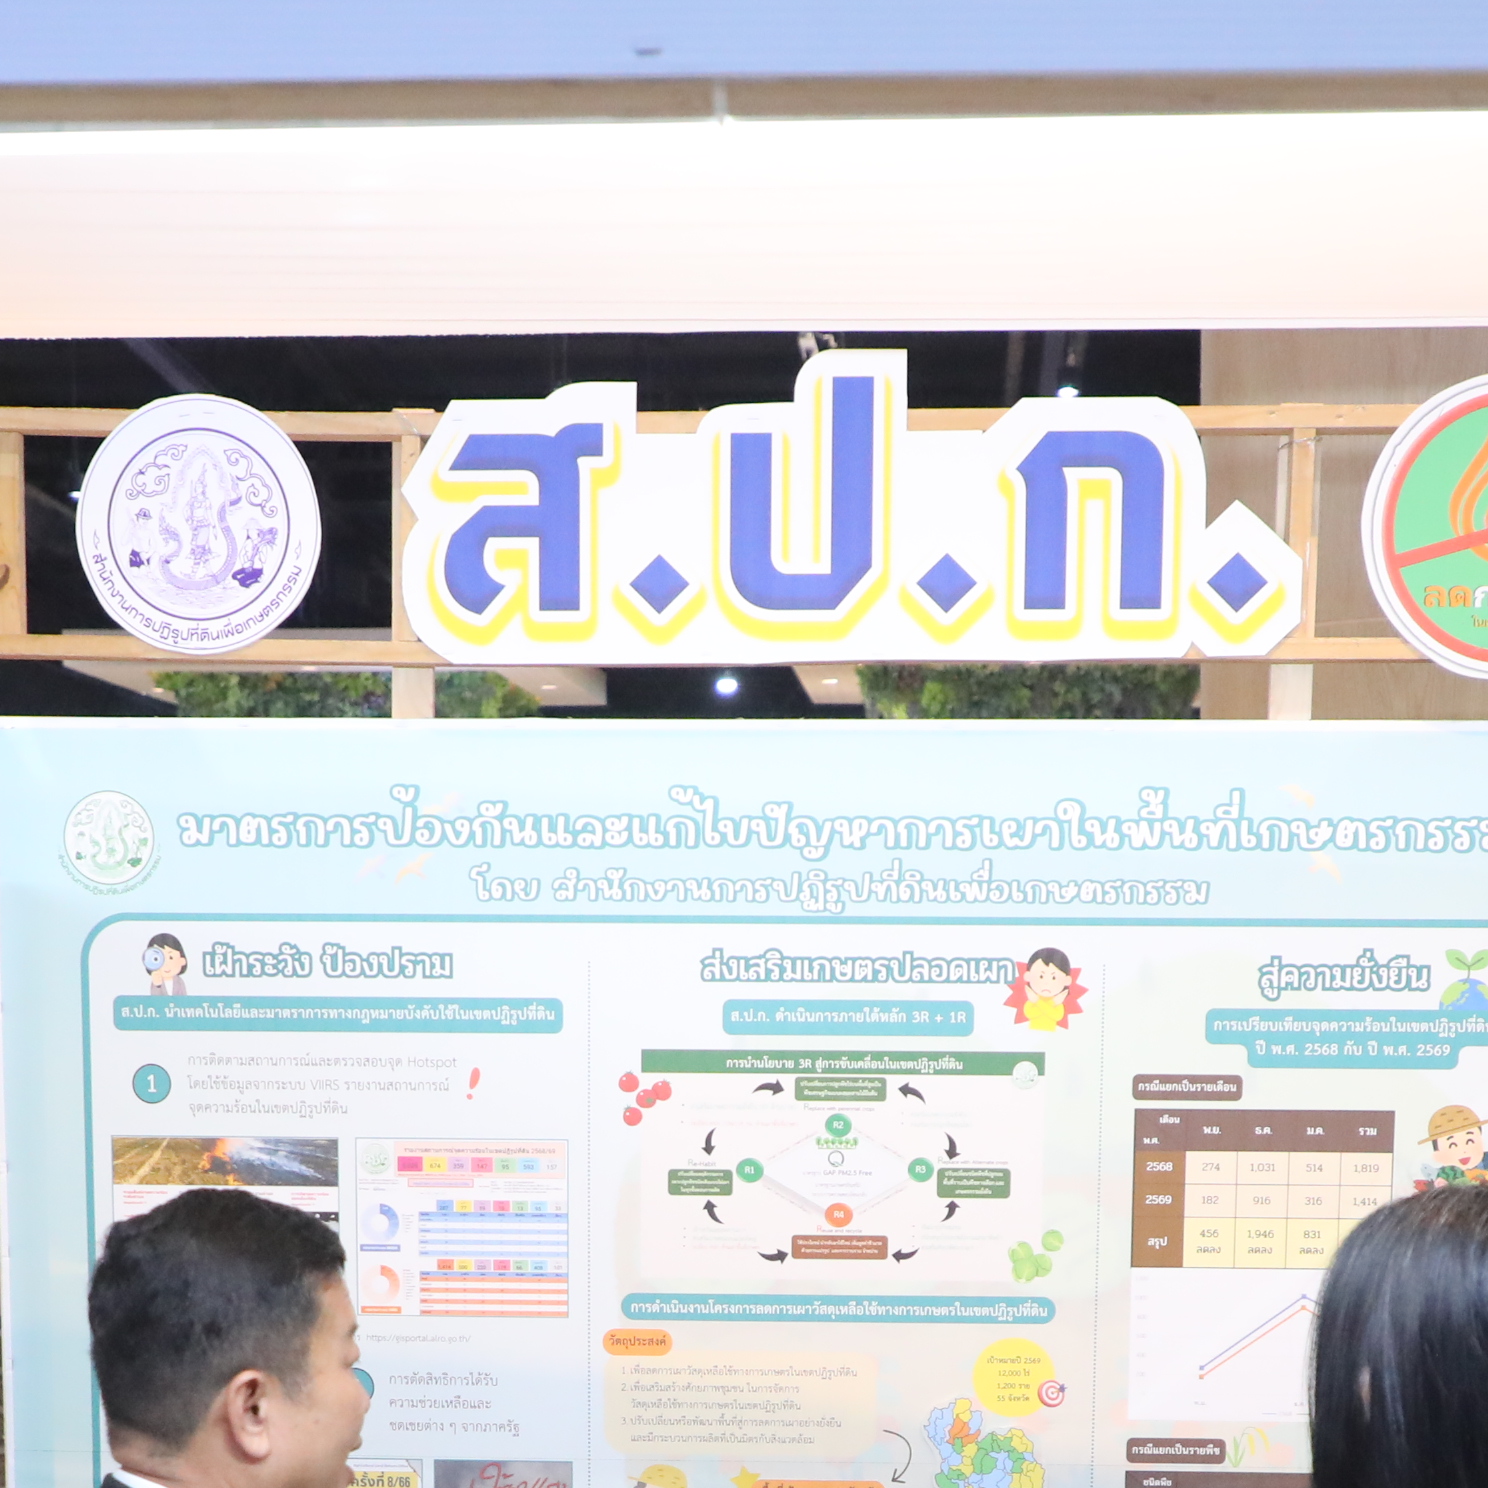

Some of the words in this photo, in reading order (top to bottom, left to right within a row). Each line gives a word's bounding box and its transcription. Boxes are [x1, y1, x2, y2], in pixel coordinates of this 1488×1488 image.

[436, 376, 1290, 630] ส.ป.ก.
[92, 553, 302, 645] สำนักงานการปฏิรูปที่ดินเพื่อเกษตรกรรม
[469, 864, 540, 904] โดย
[553, 860, 1210, 913] สำนักงานการปฏิรูปที่ดินเพื่อเกษตรกรรม
[204, 942, 312, 978] เฝ้าระวัง
[320, 942, 453, 979] ป้องปราม
[702, 948, 1017, 984] ส่งเสริมเกษตรปลอดเผา
[1259, 948, 1430, 1001] สู่ความยั่งยืน
[121, 1007, 160, 1020] ส.ป.ก.
[731, 1010, 770, 1023] ส.ป.ก.
[775, 1007, 906, 1026] ดำเนินการภายใต้หลัก
[912, 1010, 930, 1023] 3R
[949, 1010, 966, 1024] 1R
[1255, 1039, 1266, 1057] ปี
[1271, 1044, 1299, 1057] พ.ศ.
[1304, 1043, 1338, 1056] 2568
[1343, 1041, 1363, 1057] กับ
[1368, 1040, 1378, 1057] ปี
[1383, 1044, 1411, 1057] พ.ศ.
[1417, 1044, 1451, 1057] 2569
[188, 1053, 402, 1071] การติดตามสถานการณ์และตรวจสอบจุด
[408, 1056, 457, 1070] Hotspot
[726, 1057, 794, 1070] การนำนโยบาย
[798, 1058, 812, 1069] 3R
[814, 1055, 963, 1075] สู่การขับเคลื่อนในเขตปฏิรูปที่ดิน
[145, 1075, 158, 1093] 1
[187, 1075, 306, 1094] โดยใช้ข้อมูลจากระบบ
[311, 1080, 340, 1091] VIIRS
[344, 1077, 449, 1092] รายงานสถานการณ์
[1138, 1079, 1237, 1095] กรณีแยกเป็นรายเดือน
[188, 1098, 348, 1118] จุดความร้อนในเขตปฏิรูปที่ดิน
[833, 1121, 844, 1129] R2
[1159, 1113, 1181, 1124] เดือน
[1203, 1126, 1221, 1135] พ.ย.
[1255, 1126, 1273, 1135] ธ.ค.
[1307, 1126, 1325, 1136] ม.ค.
[1359, 1126, 1377, 1136] รวม
[1143, 1136, 1159, 1144] พ.ศ.
[744, 1166, 755, 1174] R1
[1146, 1161, 1173, 1172] 2568
[1201, 1162, 1220, 1173] 274
[1249, 1162, 1276, 1173] 1,031
[1305, 1162, 1324, 1173] 514
[1353, 1163, 1379, 1174] 1,819
[1145, 1194, 1172, 1205] 2569
[1201, 1195, 1219, 1205] 182
[1253, 1195, 1271, 1206] 916
[1304, 1195, 1322, 1206] 316
[1352, 1196, 1378, 1207] 1,414
[1199, 1229, 1219, 1238] 456
[1247, 1230, 1274, 1239] 1,946
[1303, 1230, 1321, 1239] 831
[1148, 1237, 1168, 1249] สรุป
[1196, 1246, 1221, 1254] ลดลง
[1248, 1246, 1272, 1254] ลดลง
[1299, 1246, 1324, 1255] ลดลง
[631, 1300, 1048, 1321] การดำเนินงานโครงการลดการเผาวัสดุเหลือใช้ทางการเกษตรในเขตปฏิรูปที่ดิน
[366, 1333, 472, 1344] https://gisportal.alro.go.th/
[609, 1335, 666, 1349] วัตถุประสงค์
[389, 1372, 498, 1388] การตัดสิทธิการได้รับ
[630, 1381, 744, 1395] เพื่อเสริมสร้างศักยภาพชุมชน
[747, 1382, 800, 1394] ในการจัดการ
[389, 1396, 492, 1410] ความช่วยเหลือและ
[631, 1398, 801, 1413] วัสดุเหลือใช้ทางการเกษตรในเขตปฏิรูปที่ดิน
[390, 1419, 444, 1433] ชดเชยต่าง
[462, 1419, 520, 1437] จากภาครัฐ
[1132, 1444, 1221, 1457] กรณีแยกเป็นรายพืช
[388, 1476, 410, 1488] 8/66
[1143, 1477, 1173, 1487] ชนิดพืช
